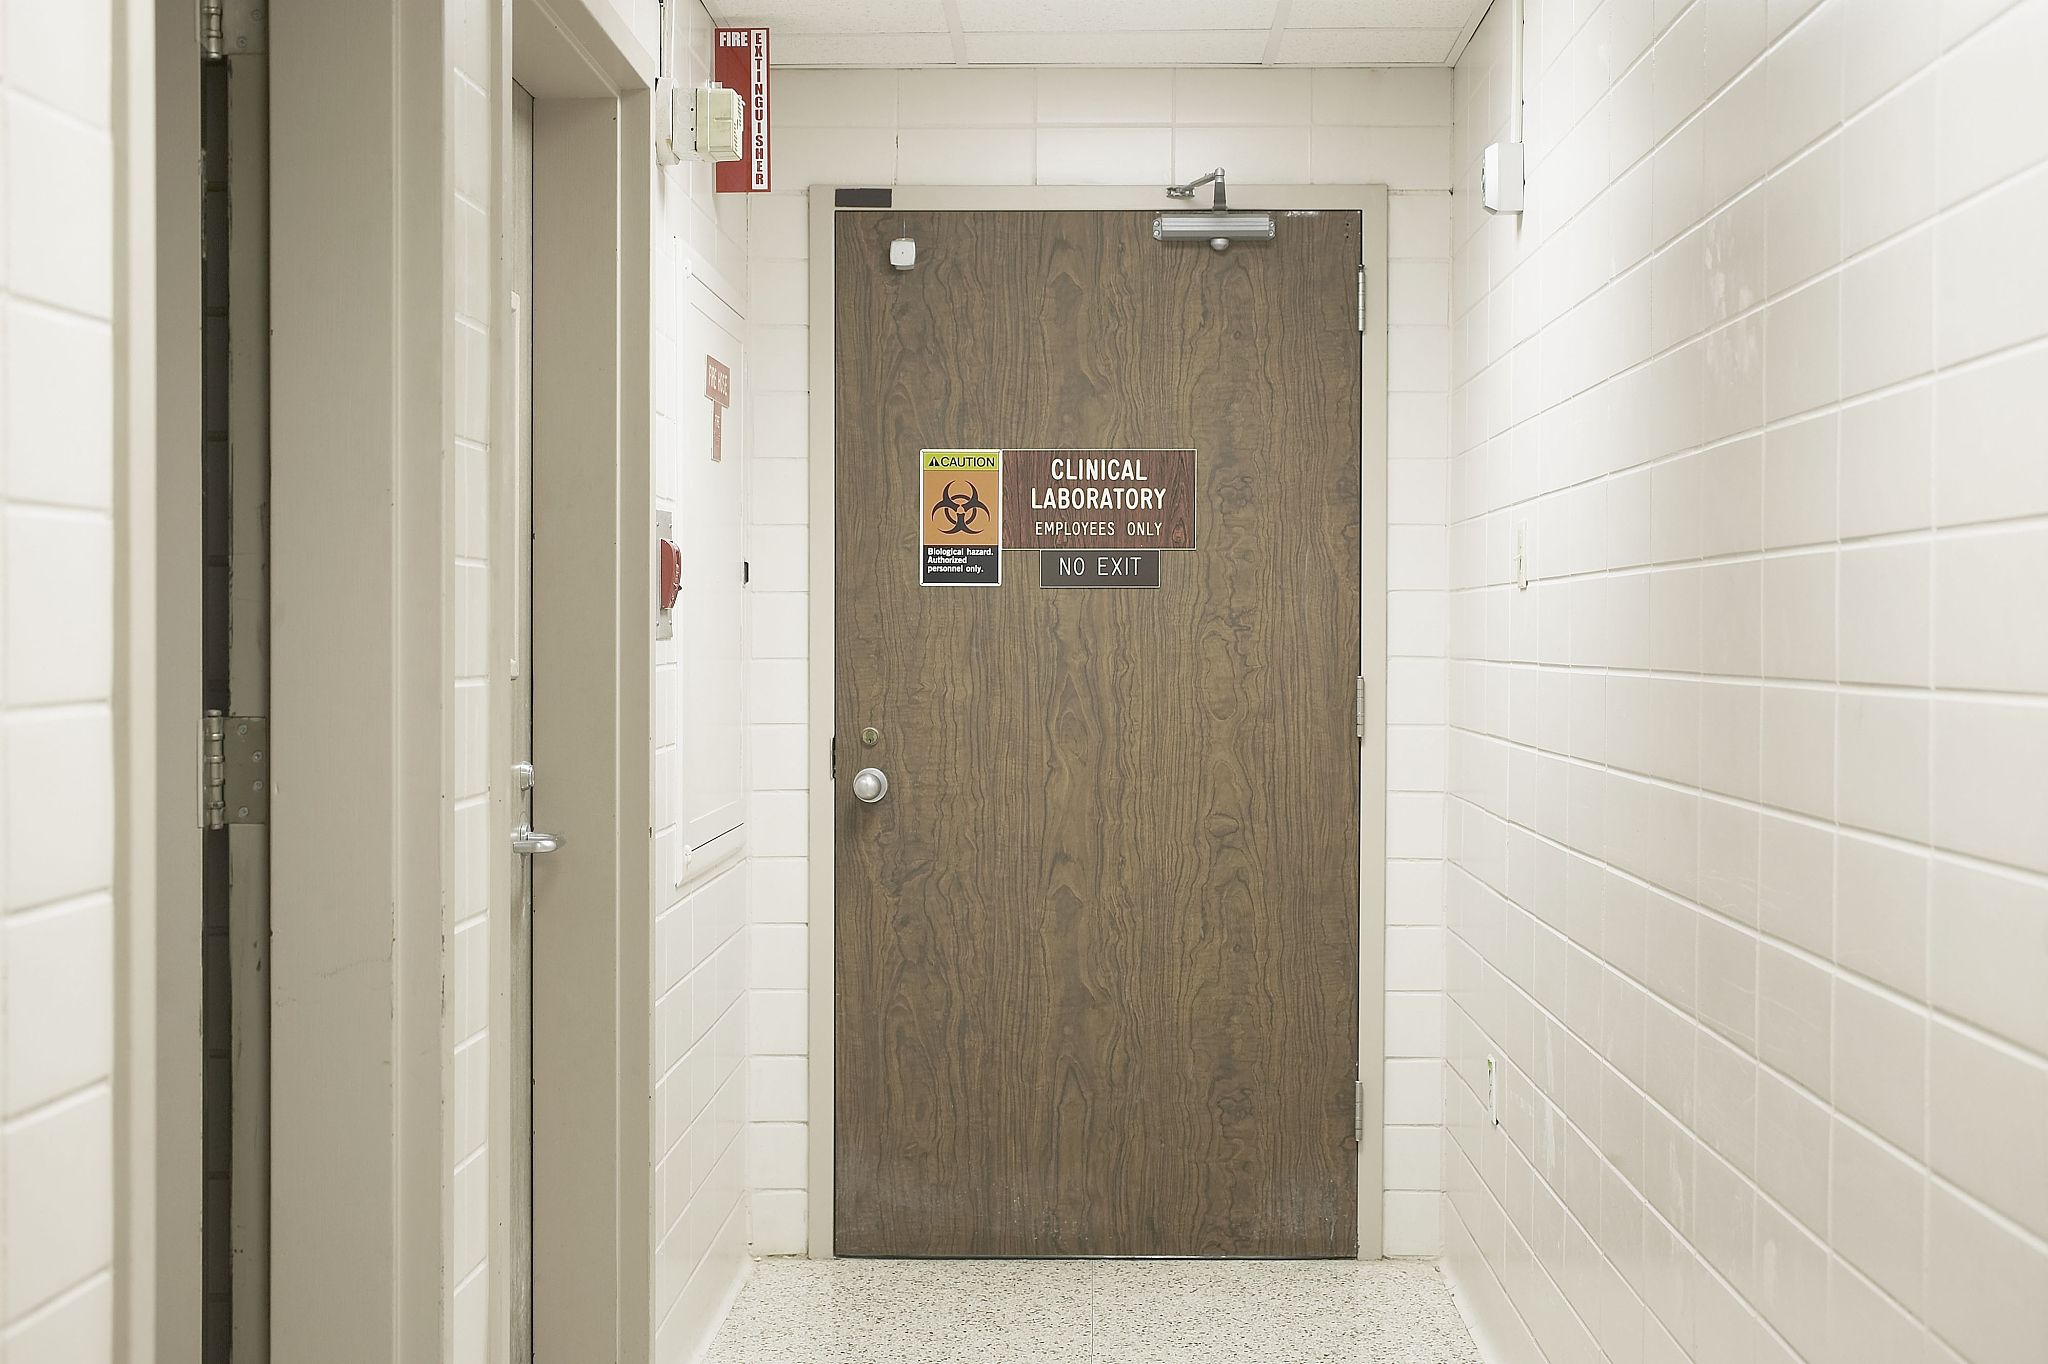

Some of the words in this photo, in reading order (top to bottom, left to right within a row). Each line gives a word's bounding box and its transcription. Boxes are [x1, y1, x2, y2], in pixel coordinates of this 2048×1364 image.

[719, 31, 748, 47] FIRE
[754, 32, 764, 185] EXTINGUISHER
[940, 456, 995, 467] CAUTION
[1051, 458, 1148, 481] CLINICAL
[1031, 488, 1166, 510] LABORATORY
[1035, 521, 1115, 536] EMPLOYEES
[1127, 521, 1162, 536] ONLY
[927, 547, 964, 557] Biological
[966, 547, 994, 556] hazard.
[927, 556, 967, 564] Authorized
[1059, 557, 1085, 576] NO
[1099, 557, 1142, 576] EXIT
[927, 564, 963, 574] personnel
[965, 564, 984, 574] only.
